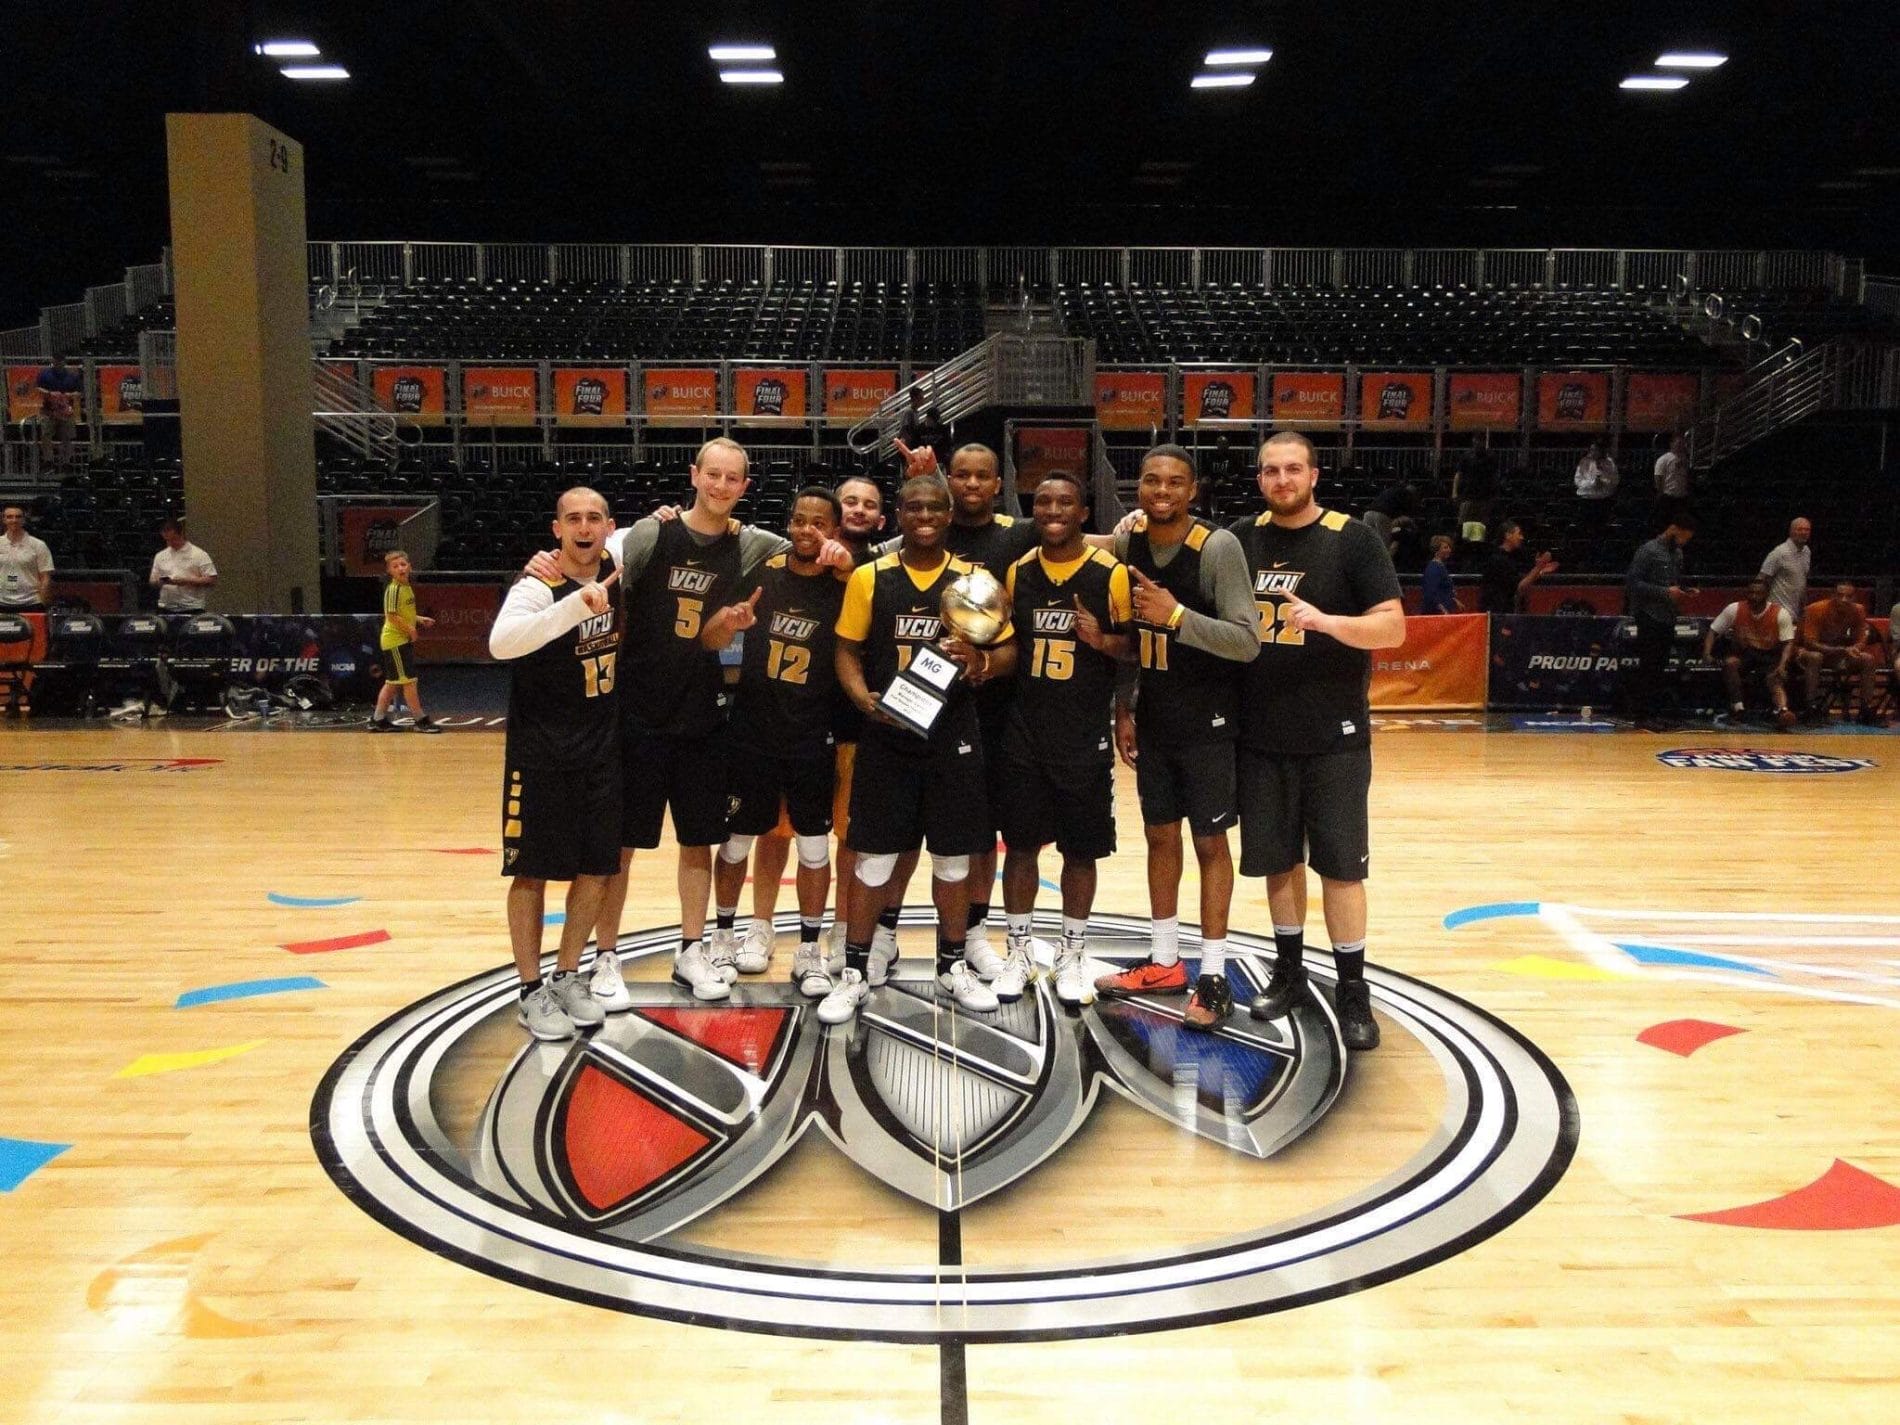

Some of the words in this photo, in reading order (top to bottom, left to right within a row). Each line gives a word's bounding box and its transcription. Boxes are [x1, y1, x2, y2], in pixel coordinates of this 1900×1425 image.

[394, 383, 420, 393] FINAL
[492, 386, 530, 398] BUICK
[575, 385, 601, 395] FINAL
[672, 386, 711, 399] BUICK
[756, 386, 781, 395] FINAL
[852, 387, 891, 400] BUICK
[1203, 389, 1229, 398] FINAL
[1382, 390, 1406, 399] FINAL
[396, 393, 421, 403] FOUR
[577, 394, 602, 403] FOUR
[757, 395, 782, 404] FOUR
[1121, 390, 1159, 402] BUICK
[1204, 398, 1229, 407] FOUR
[1299, 391, 1337, 403] BUICK
[1477, 391, 1516, 402] BUICK
[1383, 399, 1407, 408] FOUR
[671, 570, 712, 593] VCU
[1256, 572, 1298, 593] VCU
[440, 609, 493, 624] BUICK
[674, 597, 703, 639] 5
[1034, 611, 1075, 631] VCU
[1254, 601, 1304, 645] 22
[581, 612, 613, 640] VCU
[773, 615, 815, 639] VCU
[897, 617, 939, 638] VCU
[1138, 629, 1168, 671] 11
[256, 658, 280, 671] OF
[285, 658, 319, 671] THE
[767, 639, 811, 684] 12
[896, 645, 912, 672] 1
[1031, 638, 1076, 680] 15
[1528, 655, 1592, 671] PROUD
[921, 657, 942, 674] MG
[581, 652, 616, 698] 13
[1662, 758, 1758, 768] FAN
[1759, 758, 1878, 767] FEST
